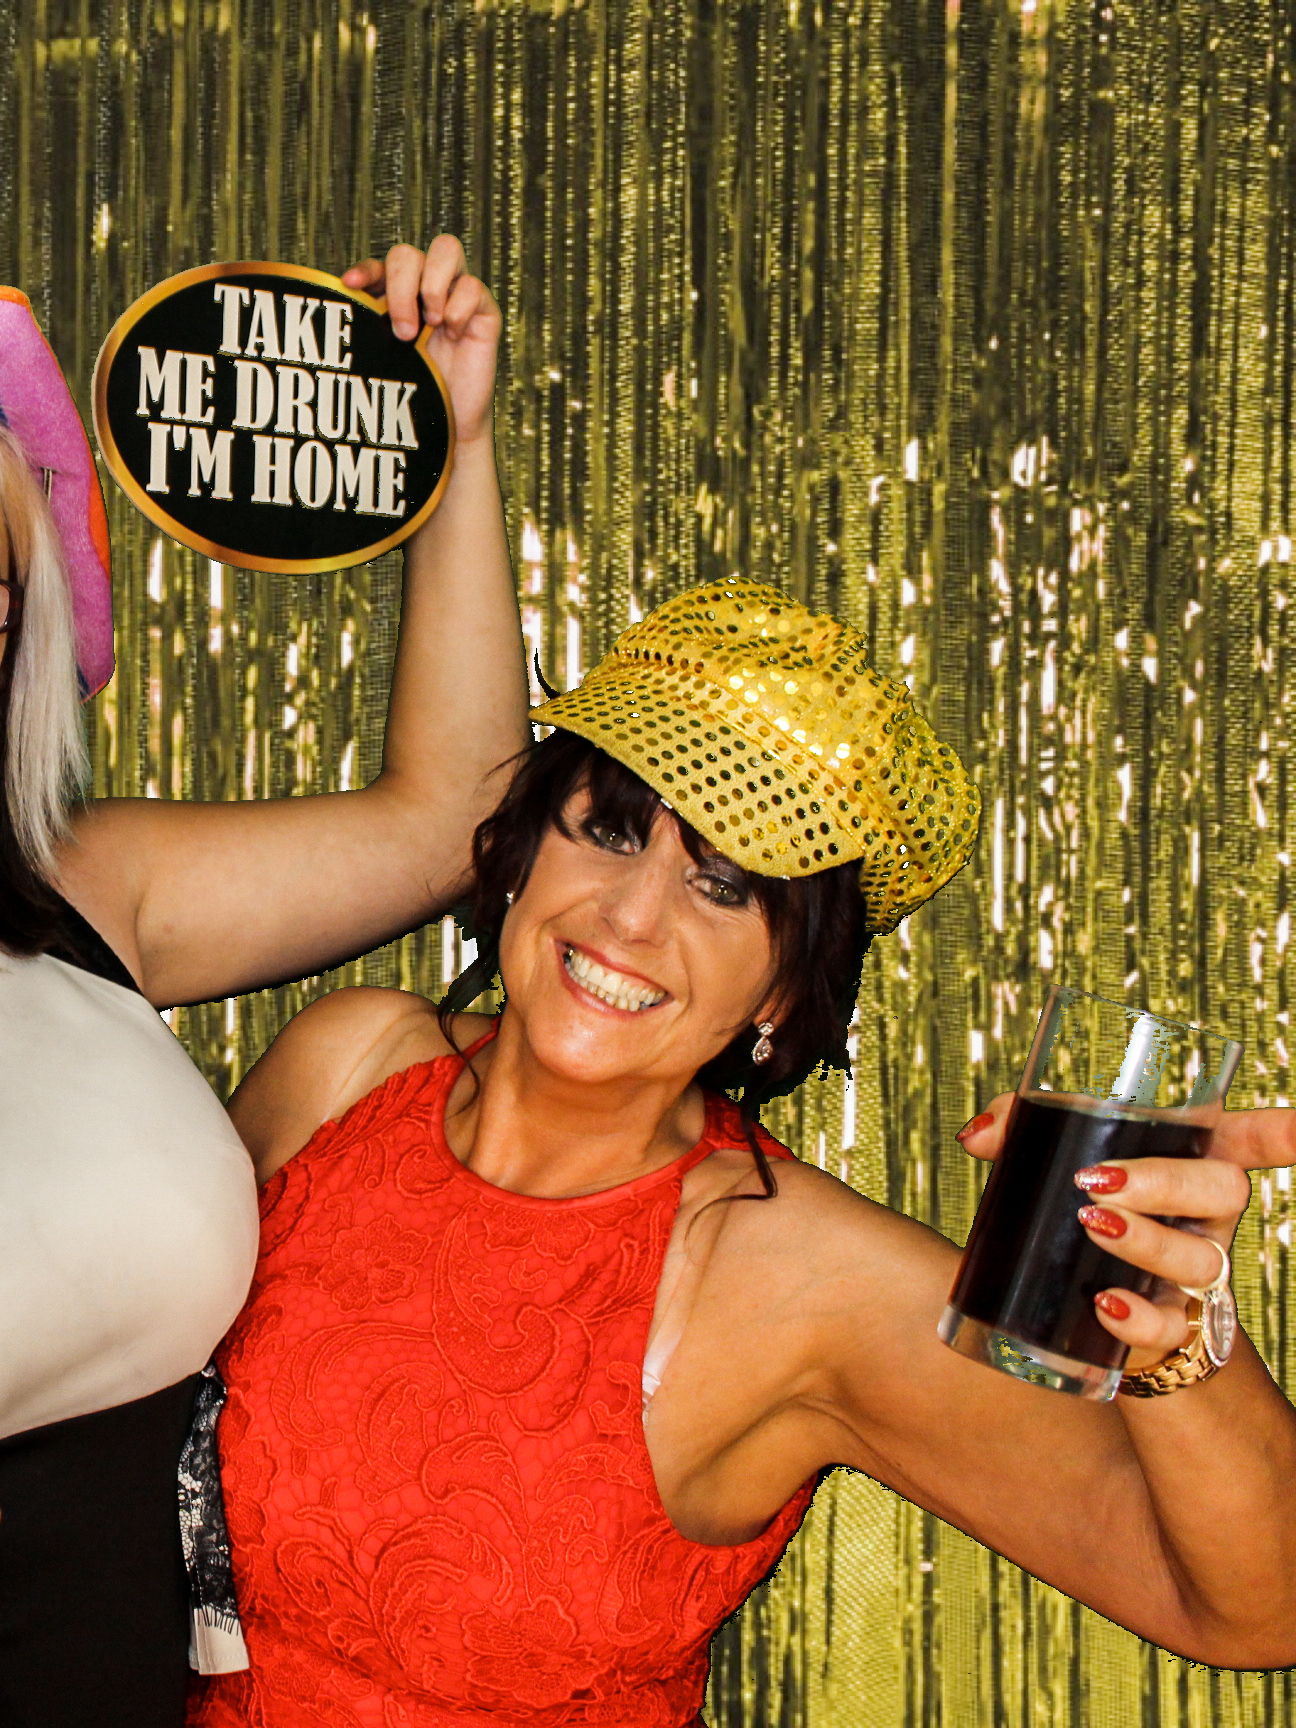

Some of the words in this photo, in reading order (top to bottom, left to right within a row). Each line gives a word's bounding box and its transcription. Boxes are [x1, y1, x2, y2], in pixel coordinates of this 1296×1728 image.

[214, 283, 353, 371] TAKE
[136, 346, 216, 424] ME
[232, 359, 419, 450] DRUNK
[146, 422, 235, 500] I'M
[251, 434, 406, 518] HOME
